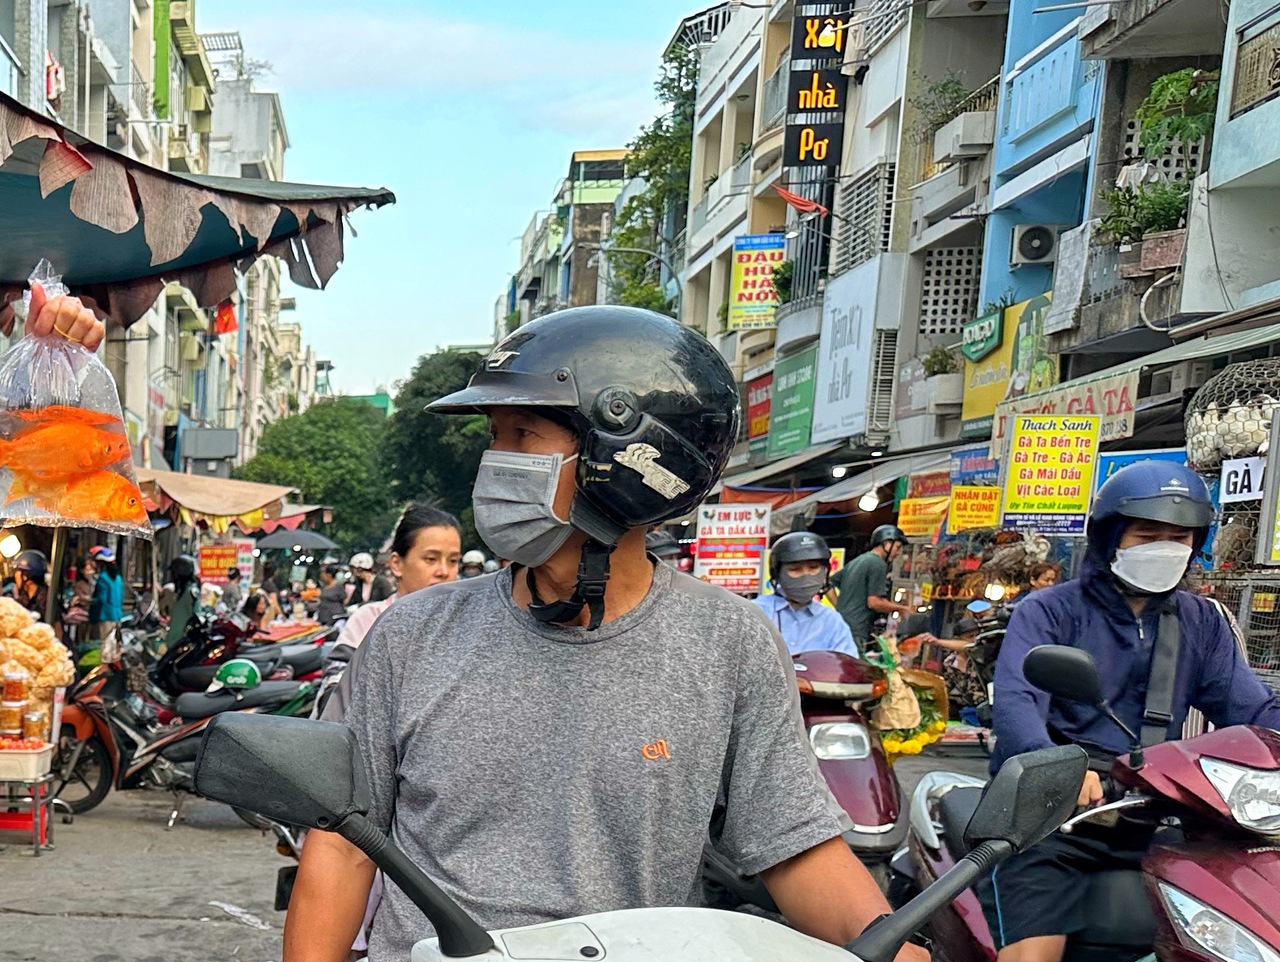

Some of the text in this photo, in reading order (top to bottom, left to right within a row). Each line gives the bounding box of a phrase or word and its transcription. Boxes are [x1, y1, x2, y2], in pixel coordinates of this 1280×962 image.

[798, 72, 839, 109] nhà
[798, 127, 830, 161] Pơ
[1103, 386, 1133, 416] TA
[1021, 419, 1056, 433] Thạch
[1060, 419, 1092, 431] Sanh
[1018, 434, 1091, 448] Gà Ta Bến Tre
[1014, 452, 1028, 464] Gà
[1032, 452, 1048, 464] Tre
[1059, 452, 1074, 464] Gà
[1076, 449, 1091, 464] Ác
[1019, 468, 1033, 480] Gà
[1036, 468, 1058, 480] Mái
[1225, 463, 1252, 496] GÀ
[1016, 484, 1081, 499] Vịt Các Loại
[717, 511, 731, 521] EM
[700, 525, 713, 535] GÀ
[716, 526, 725, 535] TA
